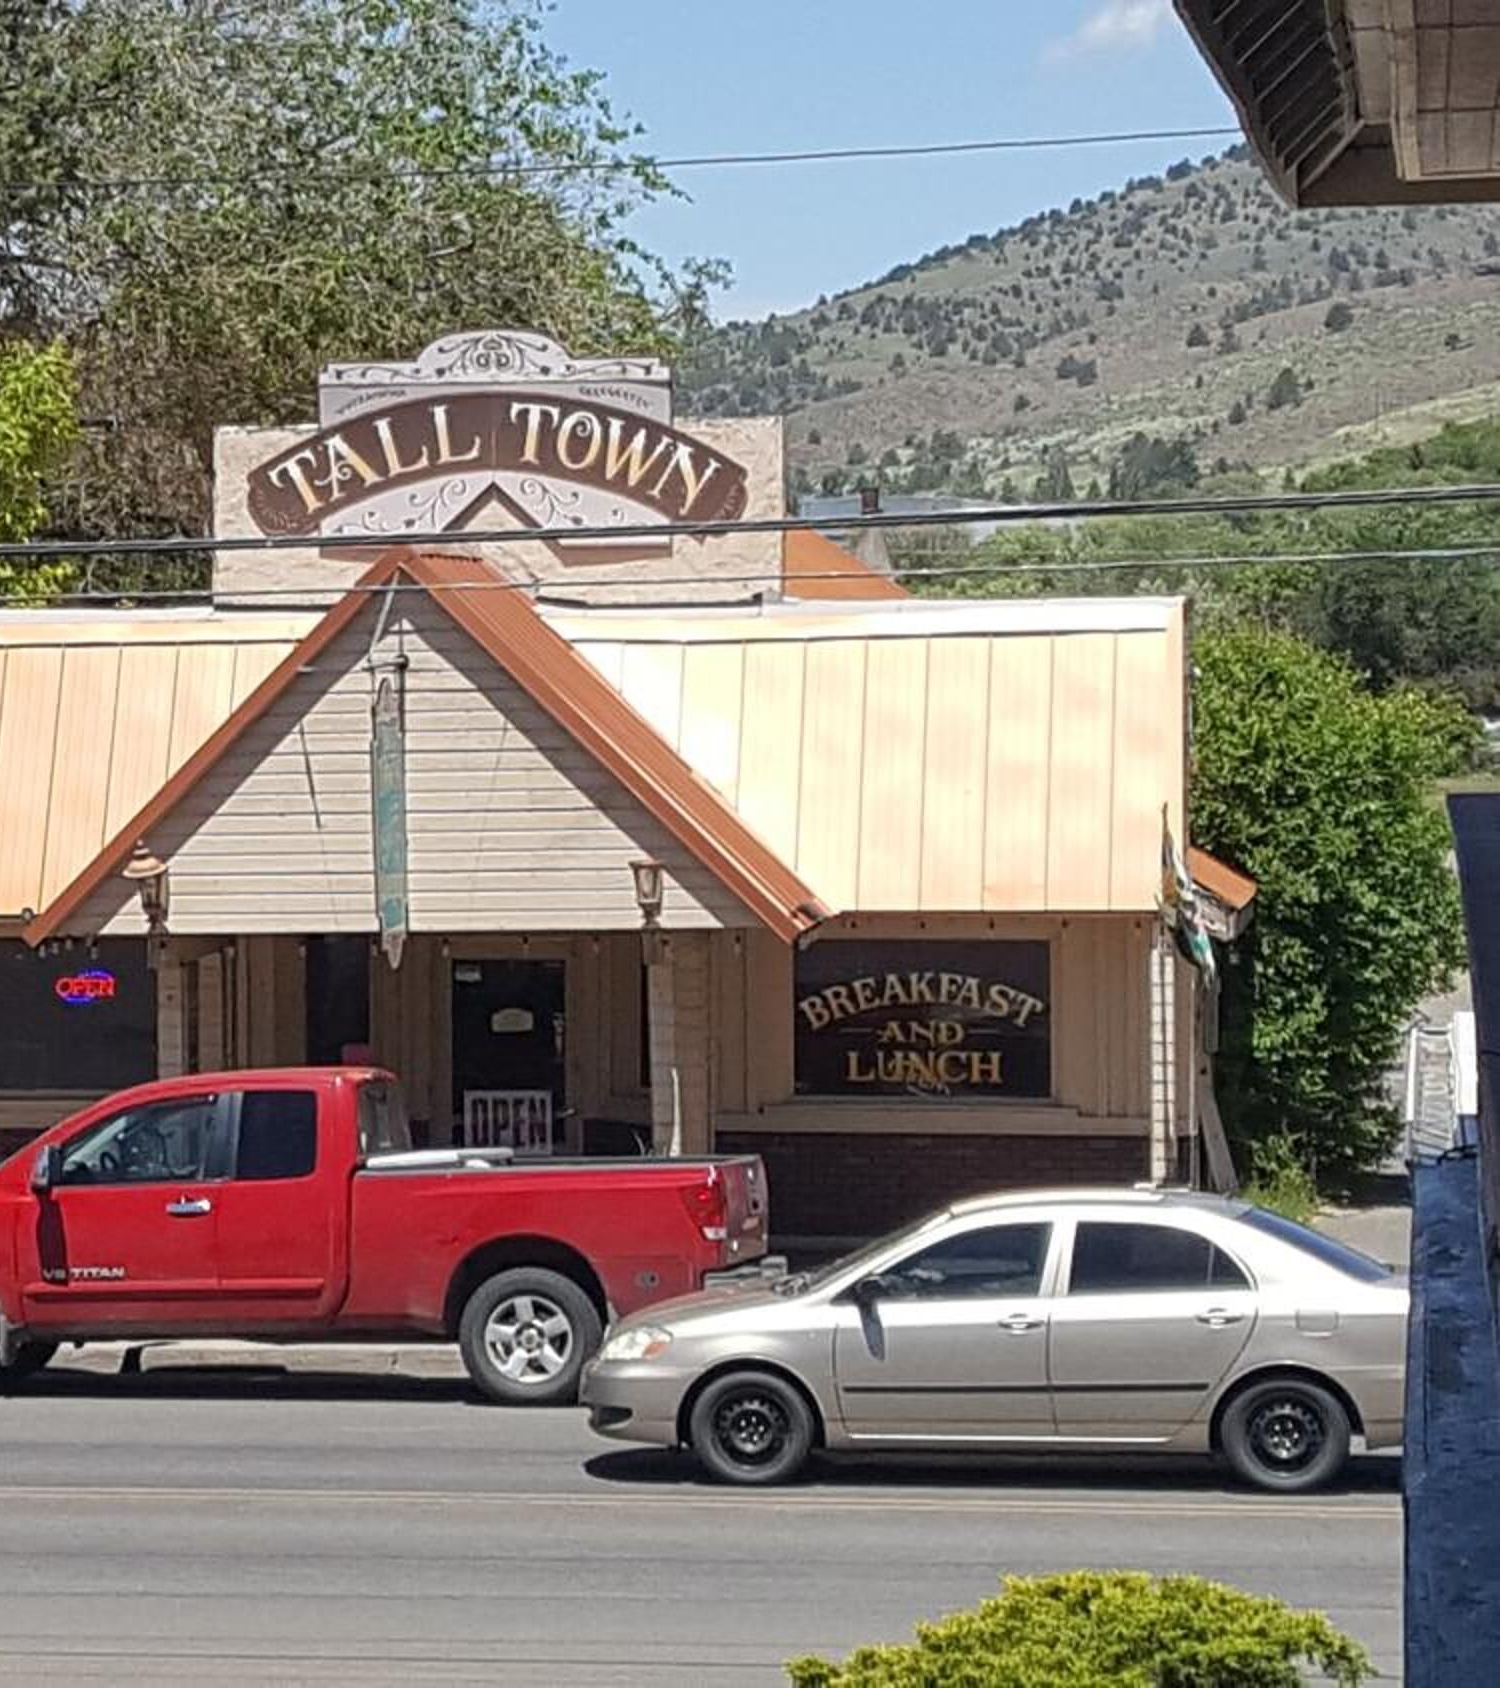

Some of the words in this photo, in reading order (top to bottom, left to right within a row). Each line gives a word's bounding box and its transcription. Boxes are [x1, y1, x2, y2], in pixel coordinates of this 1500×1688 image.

[269, 404, 481, 514] TALL
[510, 402, 721, 515] TOWN
[55, 977, 115, 998] OPEN
[799, 972, 1043, 1031] BREAKFAST
[876, 1019, 965, 1046] AND
[846, 1051, 1003, 1084] LUNCH
[470, 1096, 548, 1149] OPEN
[69, 1266, 125, 1279] TITAN
